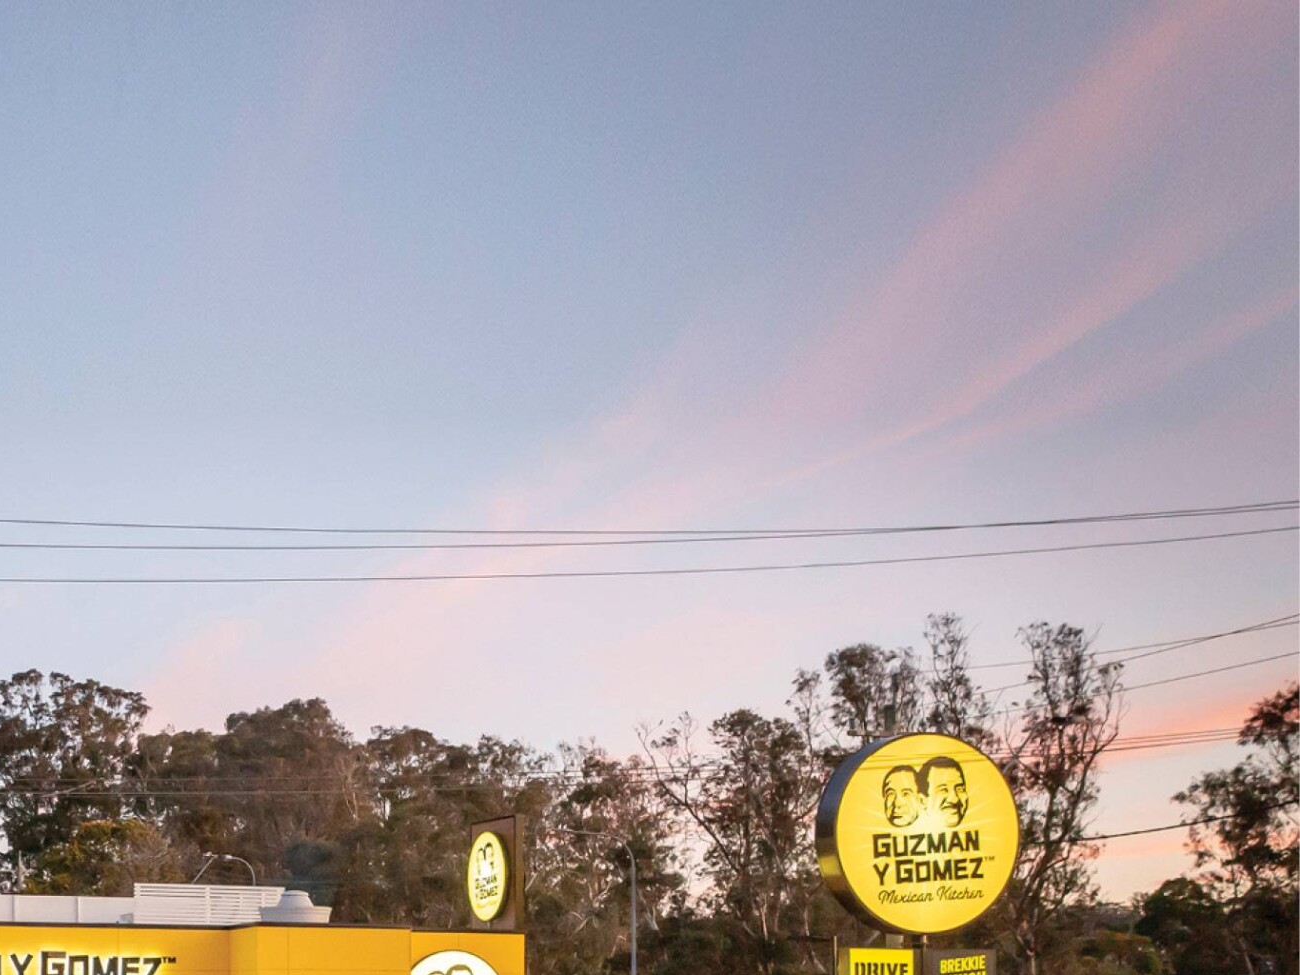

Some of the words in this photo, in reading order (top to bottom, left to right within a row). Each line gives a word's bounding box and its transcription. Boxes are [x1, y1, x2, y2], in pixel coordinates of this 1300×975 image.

[872, 830, 980, 859] GUZMAN
[872, 862, 890, 886] Y
[878, 890, 933, 904] Mexican
[936, 886, 984, 900] Kitchen
[940, 954, 986, 974] BREKKIE
